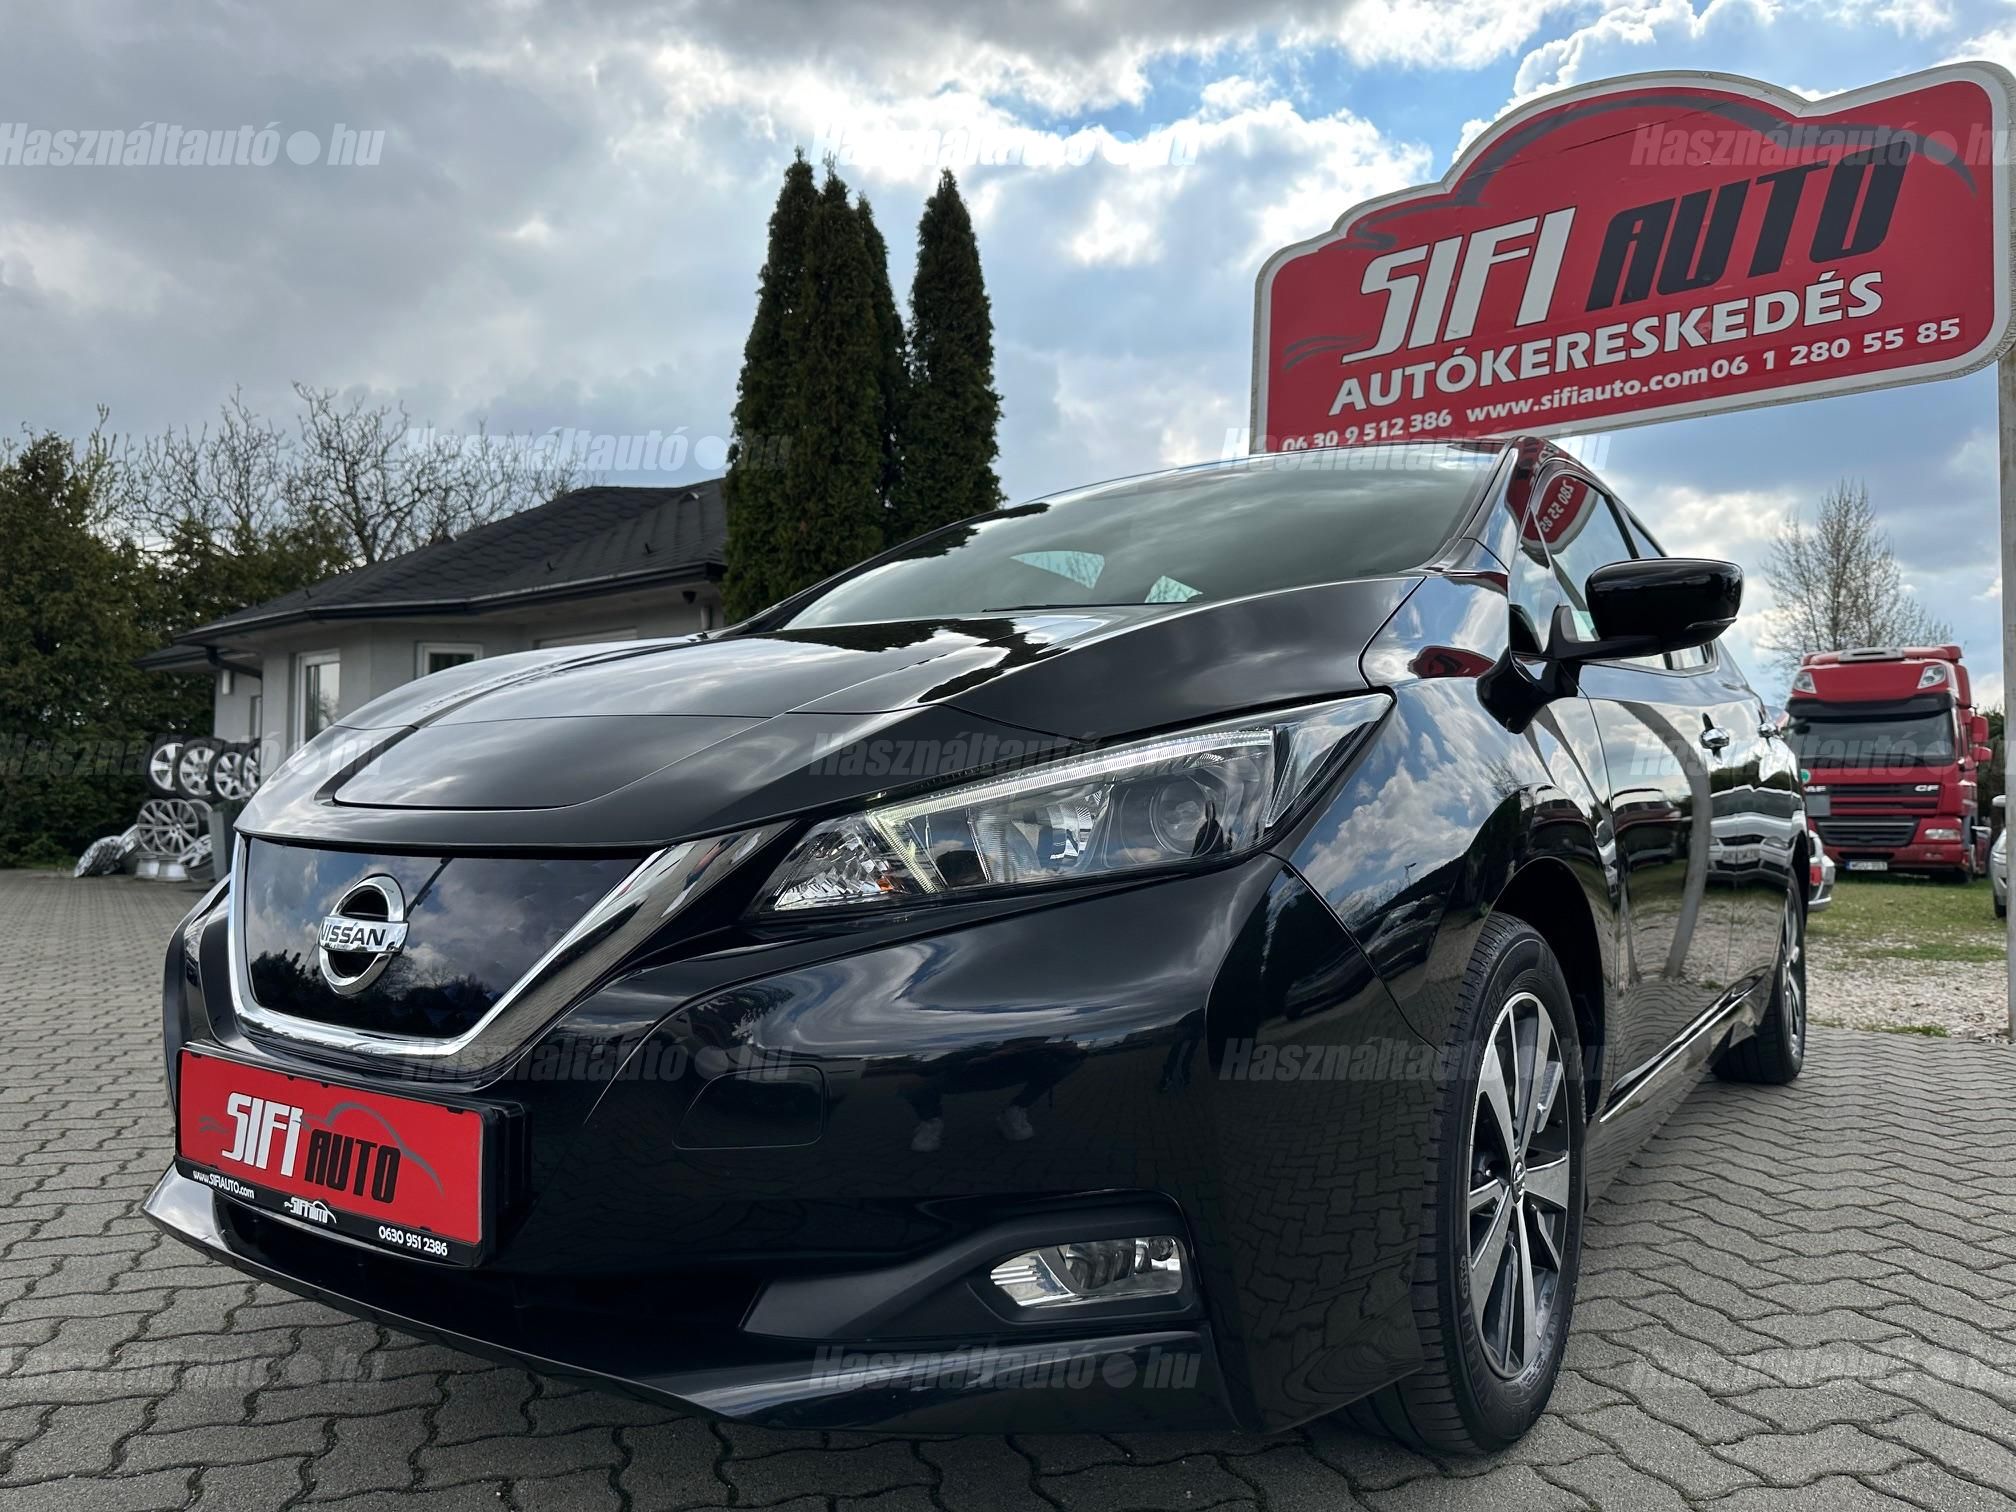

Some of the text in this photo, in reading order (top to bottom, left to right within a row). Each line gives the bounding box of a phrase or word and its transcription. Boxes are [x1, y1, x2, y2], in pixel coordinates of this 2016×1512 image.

[1341, 141, 1912, 364] SIFI AUTO
[1328, 270, 1883, 416] AUTÓKERESKEDÉS
[1345, 426, 1359, 444] 9
[1363, 417, 1404, 441] 512
[1409, 409, 1452, 433] 386
[1466, 366, 1708, 423] www.sifiauto.com
[1710, 356, 1748, 378] 06
[1763, 350, 1774, 370] 1
[1789, 338, 1850, 366] 280
[1863, 328, 1904, 354] 55
[1916, 317, 1960, 344] 85
[320, 924, 386, 946] NISSAN
[222, 1092, 402, 1204] SIFI AUTO
[378, 1225, 448, 1256] 0630 951 2386
